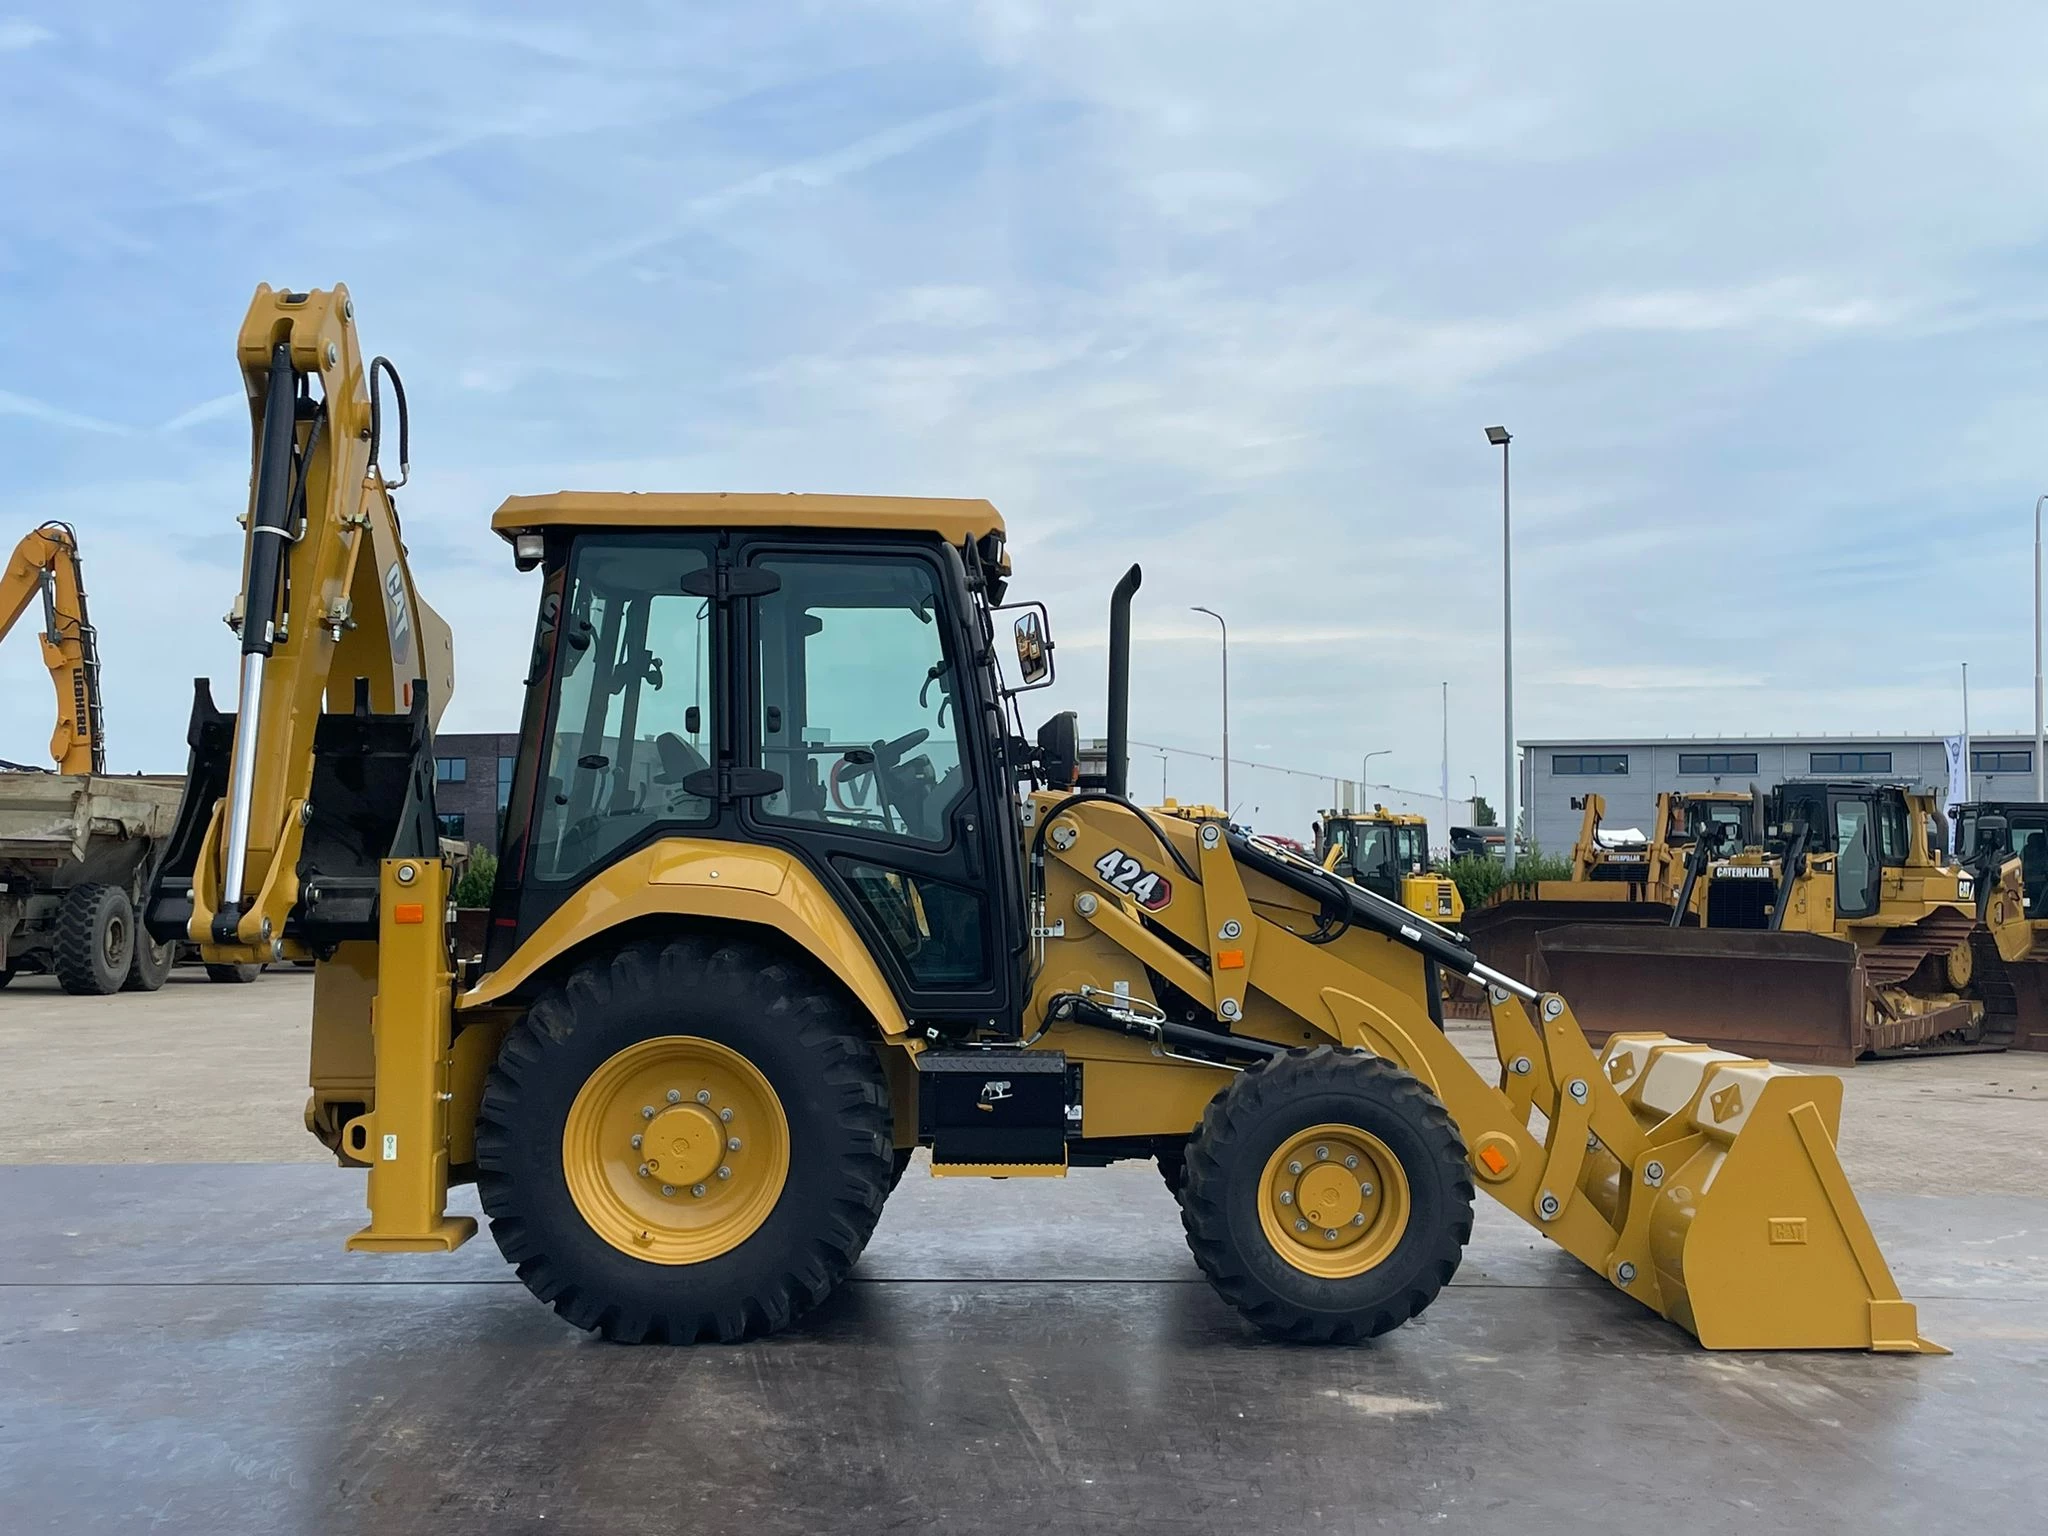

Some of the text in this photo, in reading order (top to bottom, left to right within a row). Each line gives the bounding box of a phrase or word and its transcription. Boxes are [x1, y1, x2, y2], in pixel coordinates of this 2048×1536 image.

[385, 561, 410, 641] CAT
[72, 667, 87, 736] LIEBHERR
[1608, 854, 1641, 862] CATERPILLAR
[1716, 866, 1770, 878] CATERPILLAR
[1095, 849, 1160, 904] 424
[1958, 880, 1971, 898] CAT
